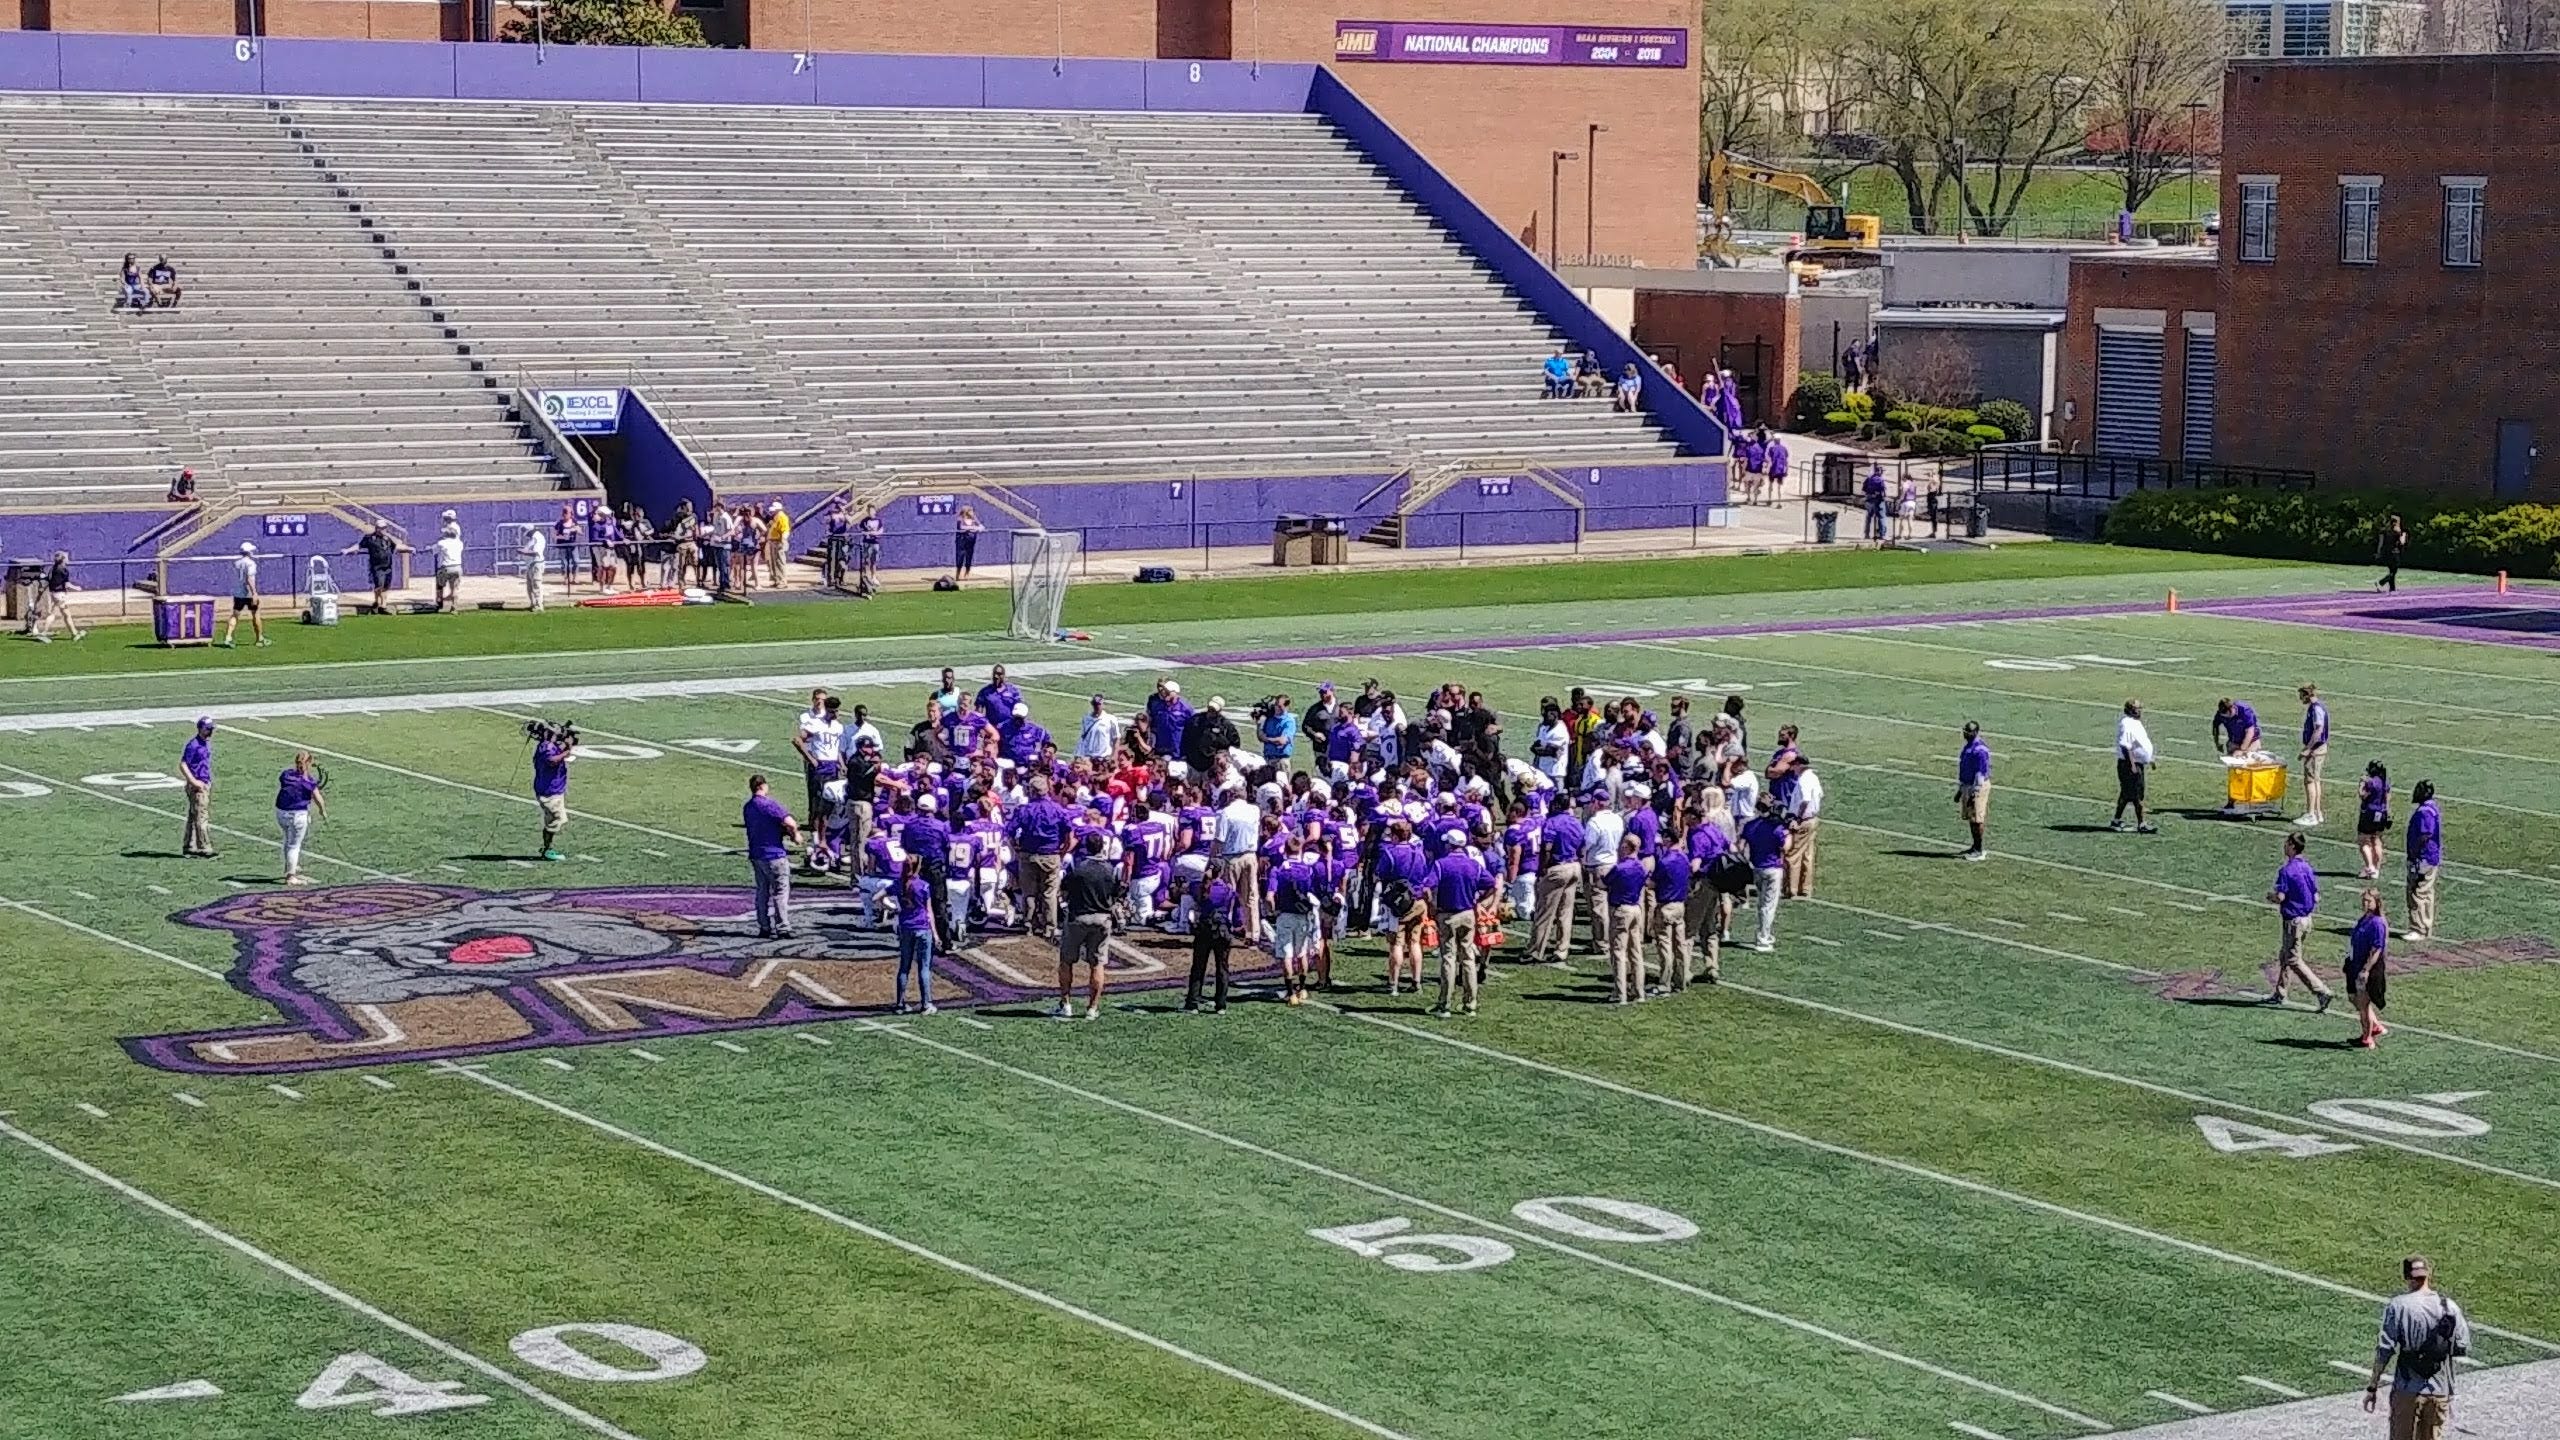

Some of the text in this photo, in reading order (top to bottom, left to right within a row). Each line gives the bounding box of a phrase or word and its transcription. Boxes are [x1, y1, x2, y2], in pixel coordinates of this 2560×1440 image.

[235, 40, 250, 61] 6
[1336, 32, 1376, 52] JMU
[1404, 35, 1550, 54] NATIONAL CHAMPIONS
[793, 53, 805, 75] 7
[1190, 62, 1201, 83] 8
[1590, 468, 1600, 483] 8
[1172, 482, 1182, 498] 7
[576, 500, 587, 517] 6
[944, 503, 952, 513] 7
